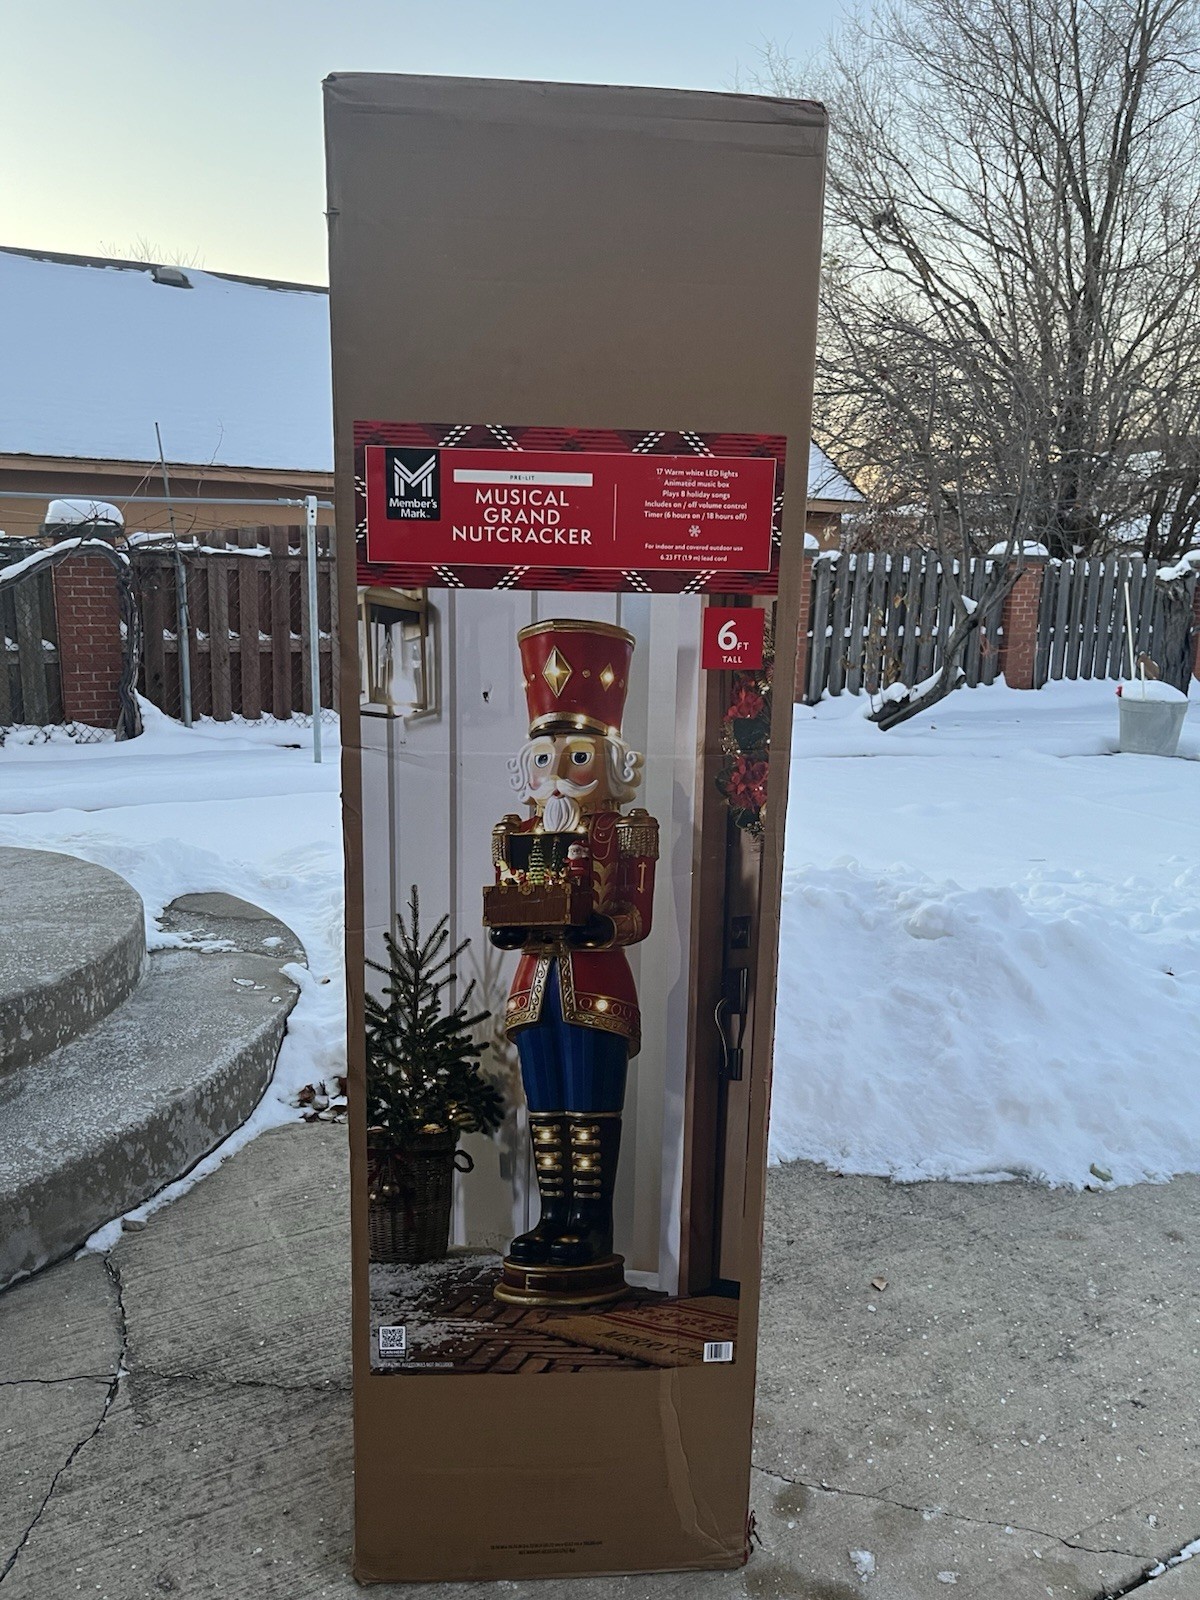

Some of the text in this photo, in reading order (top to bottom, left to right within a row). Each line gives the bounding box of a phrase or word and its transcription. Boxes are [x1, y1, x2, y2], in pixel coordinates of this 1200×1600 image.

[720, 470, 738, 479] lights
[475, 488, 569, 506] MUSICAL
[662, 490, 680, 499] Plays
[687, 490, 710, 499] holiday
[389, 498, 437, 509] Member's
[400, 508, 426, 518] Mark
[484, 508, 560, 525] GRAND
[735, 512, 747, 521] off)
[452, 526, 592, 544] NUTCRACKER
